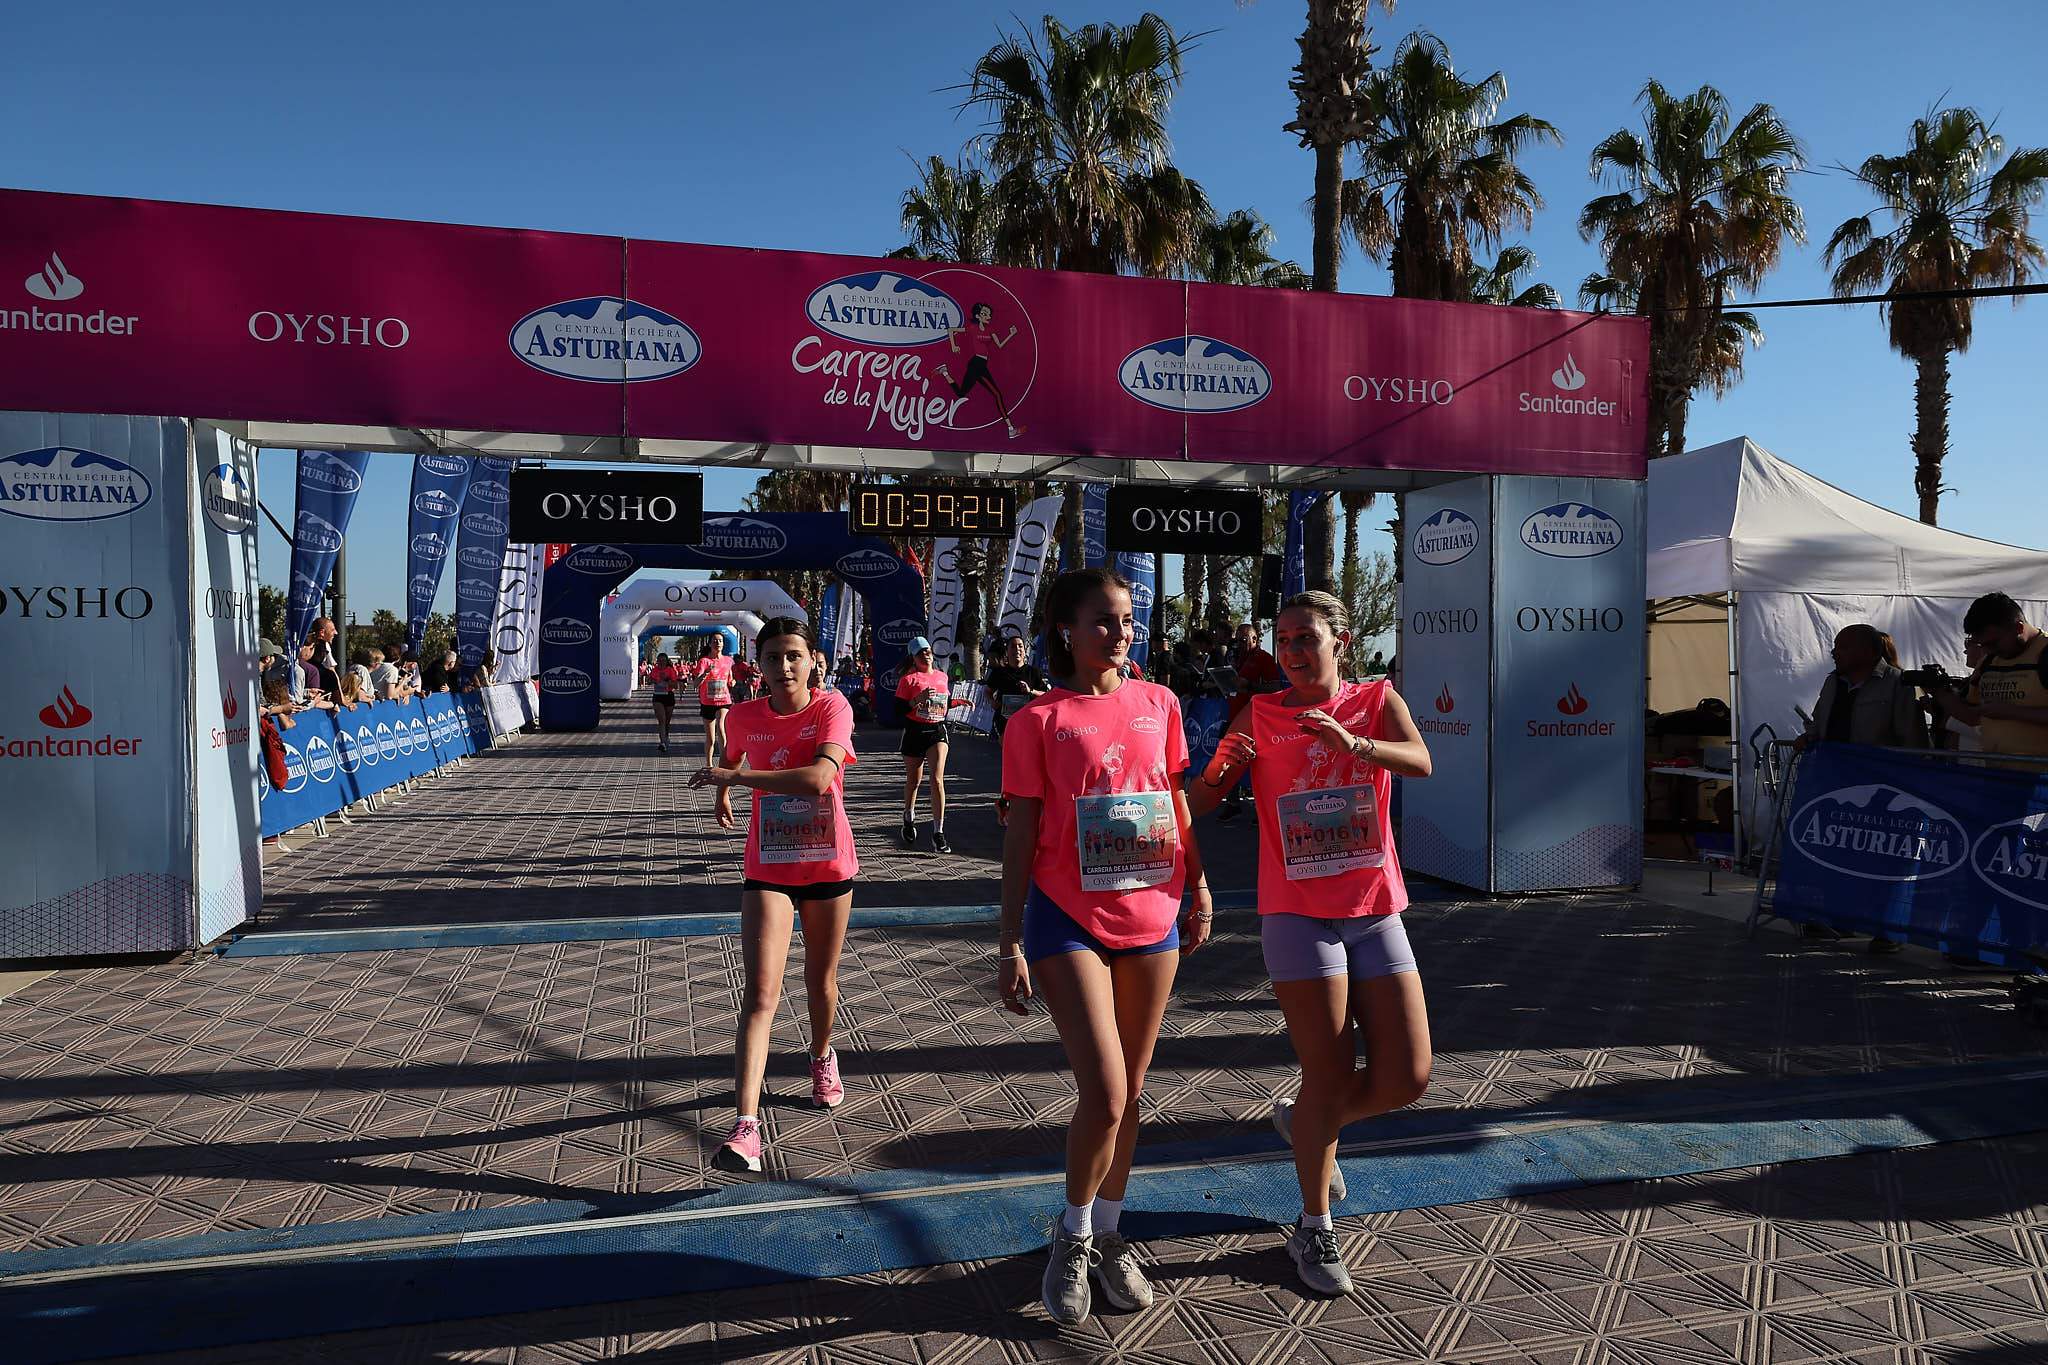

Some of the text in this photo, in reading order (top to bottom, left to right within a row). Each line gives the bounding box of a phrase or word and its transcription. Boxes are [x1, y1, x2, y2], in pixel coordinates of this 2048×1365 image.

[818, 294, 952, 330] ASTURIANA
[843, 294, 947, 309] CENTRAL LECHERA
[0, 306, 139, 335] antander
[248, 311, 410, 348] OYSHO
[555, 324, 616, 335] CENTRAL
[525, 324, 687, 363] ASTURIANA
[792, 336, 922, 380] Carrera
[1154, 360, 1256, 373] CENTRAL LECHERA
[1130, 361, 1261, 395] ASTURIANA
[1343, 375, 1454, 405] OYSHO
[823, 376, 969, 441] de la Mujer
[1519, 392, 1616, 417] Santander
[13, 471, 133, 483] CENTRAL LECHERA
[541, 492, 677, 522] OYSHO
[861, 493, 1004, 529] 00:39:24
[1131, 507, 1241, 535] OYSHO
[704, 535, 780, 549] STURIANA
[1417, 530, 1474, 554] ASTURIANA
[1528, 522, 1616, 545] ASTURIANA
[570, 555, 628, 569] ASTURIANA
[841, 558, 896, 571] ASTURIANA
[0, 586, 154, 620] YSHO
[205, 587, 252, 621] OYSHO
[496, 547, 527, 656] OYSH
[664, 585, 747, 603] OYSHO
[1413, 608, 1478, 635] OYSHO
[1516, 606, 1624, 633] OYSHO
[543, 628, 589, 639] ASTURIANA
[542, 676, 588, 688] ASTURIANA
[211, 726, 251, 749] Santander
[1056, 725, 1098, 742] OYSHO
[1417, 716, 1471, 737] Santander
[1527, 719, 1616, 737] Santander
[1799, 809, 1951, 866] ASTURIANA
[1086, 866, 1113, 874] CARRERA
[1290, 855, 1314, 864] CARRERA
[1297, 865, 1328, 874] OYSHO
[1093, 877, 1126, 886] OYSHO
